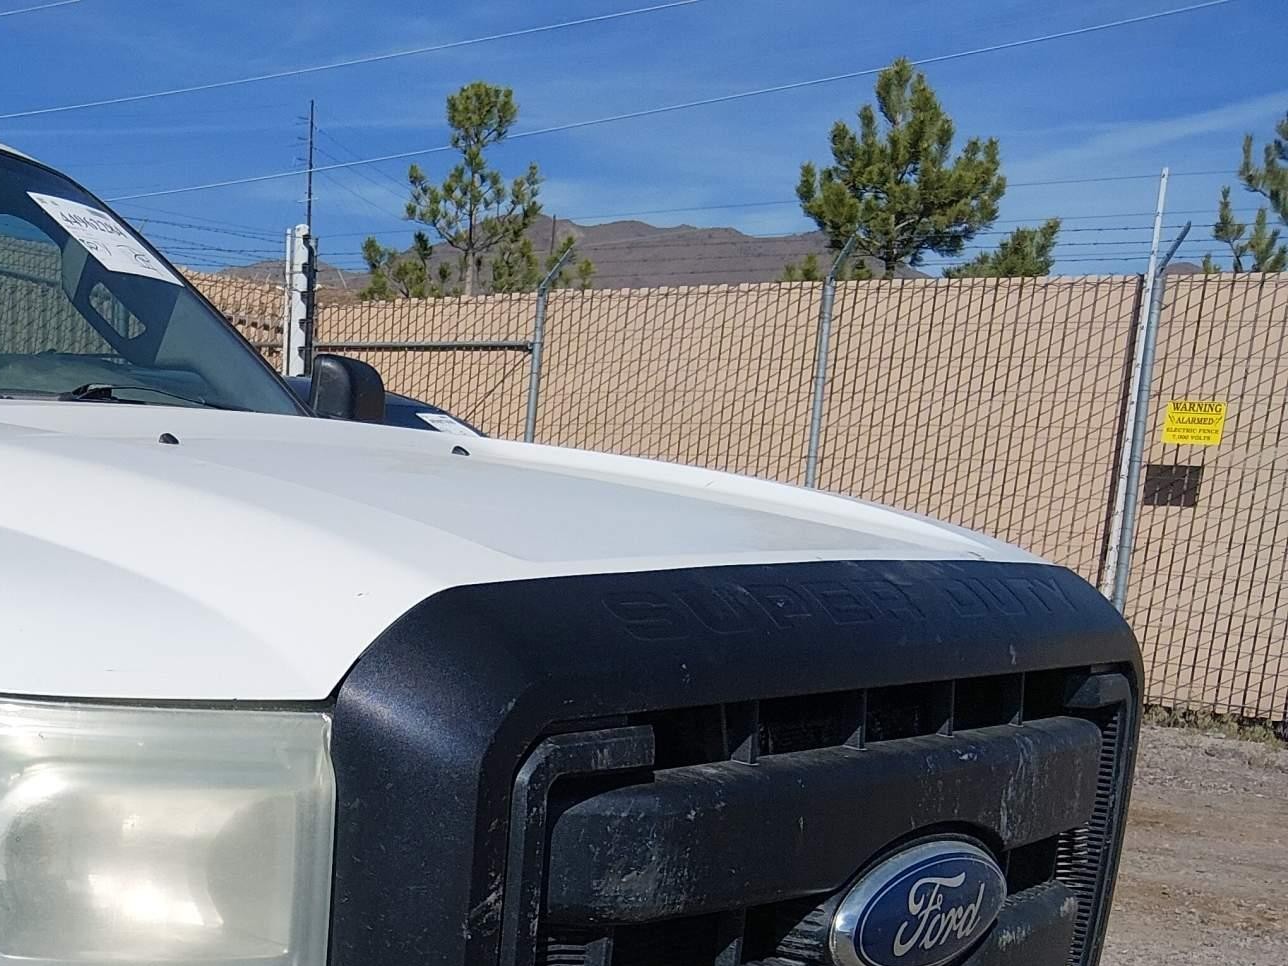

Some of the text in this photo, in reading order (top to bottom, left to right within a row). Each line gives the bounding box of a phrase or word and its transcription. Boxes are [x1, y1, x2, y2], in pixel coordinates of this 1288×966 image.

[1173, 402, 1223, 412] WARNING
[1176, 416, 1214, 425] ALARMED
[600, 576, 1079, 642] SUPER DUTY
[893, 872, 985, 957] Ford
